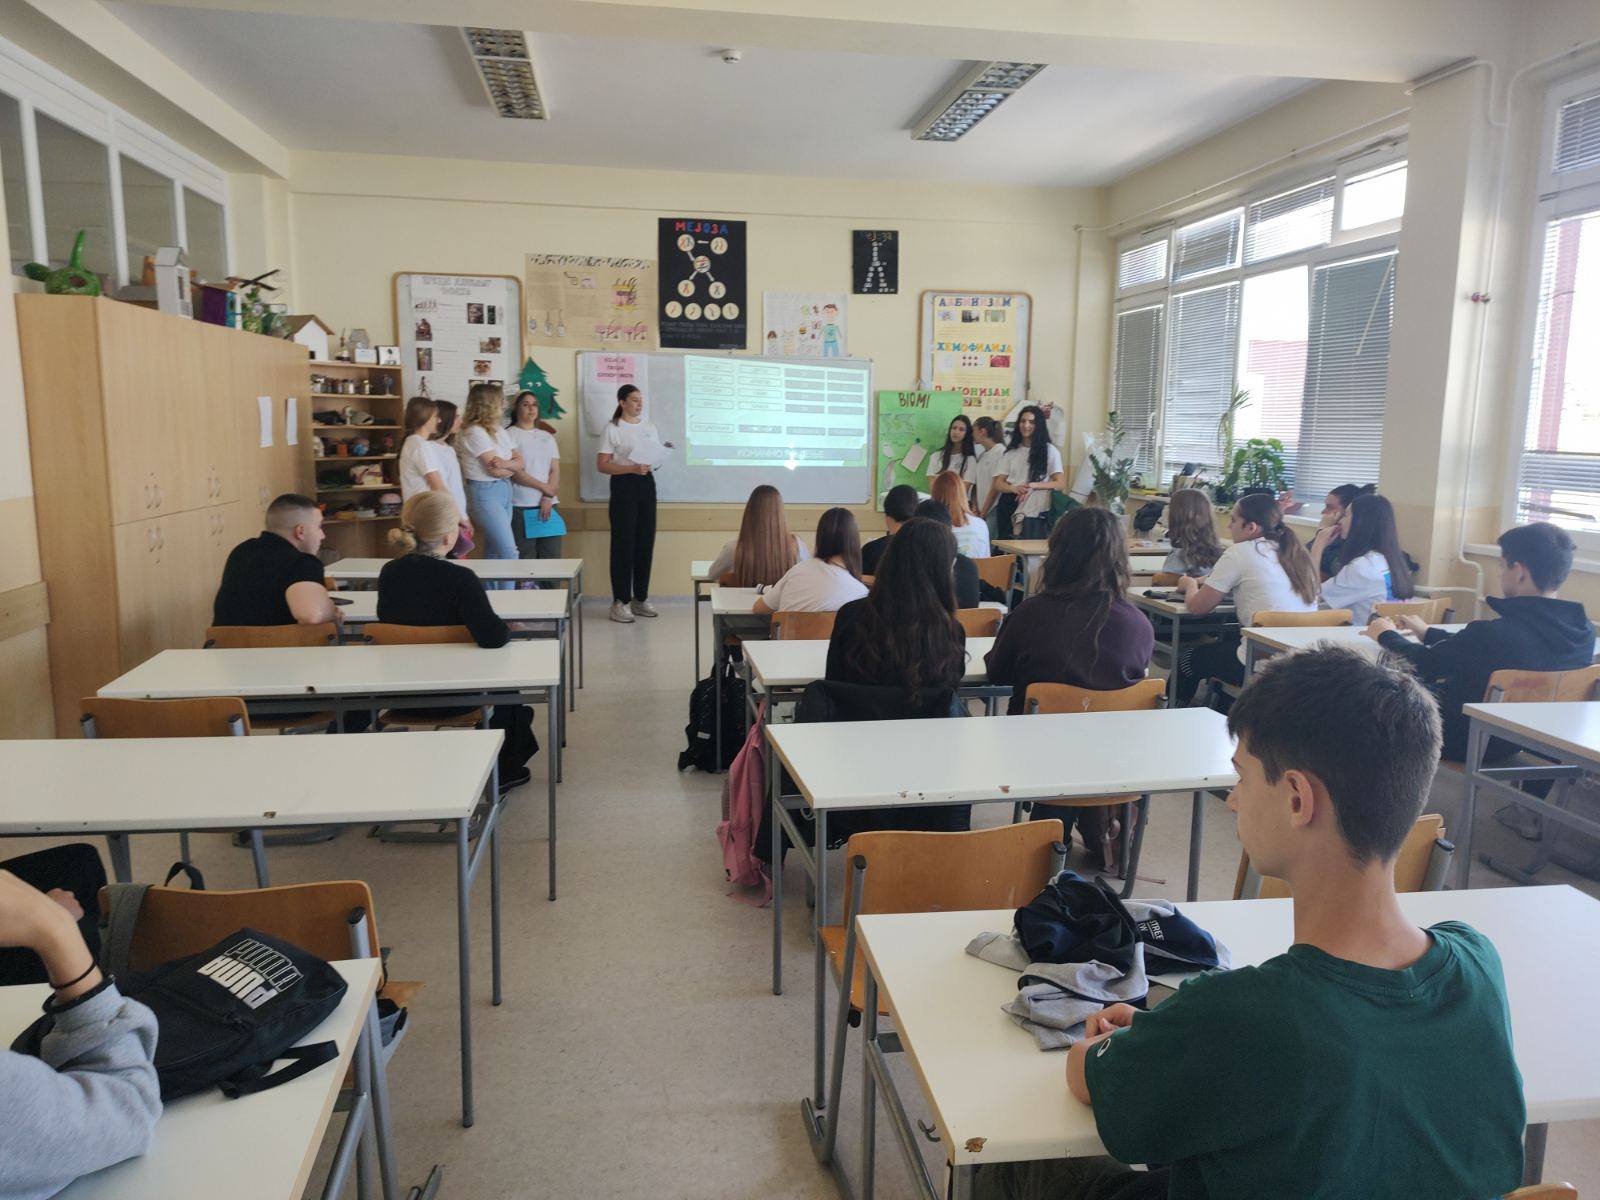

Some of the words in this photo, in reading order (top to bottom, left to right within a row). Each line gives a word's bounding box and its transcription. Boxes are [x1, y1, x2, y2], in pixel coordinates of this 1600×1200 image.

[675, 221, 729, 234] МЕЈОЗА
[937, 342, 1013, 353] ХЕМОФИЛИЈА
[196, 953, 279, 1010] PUMA
